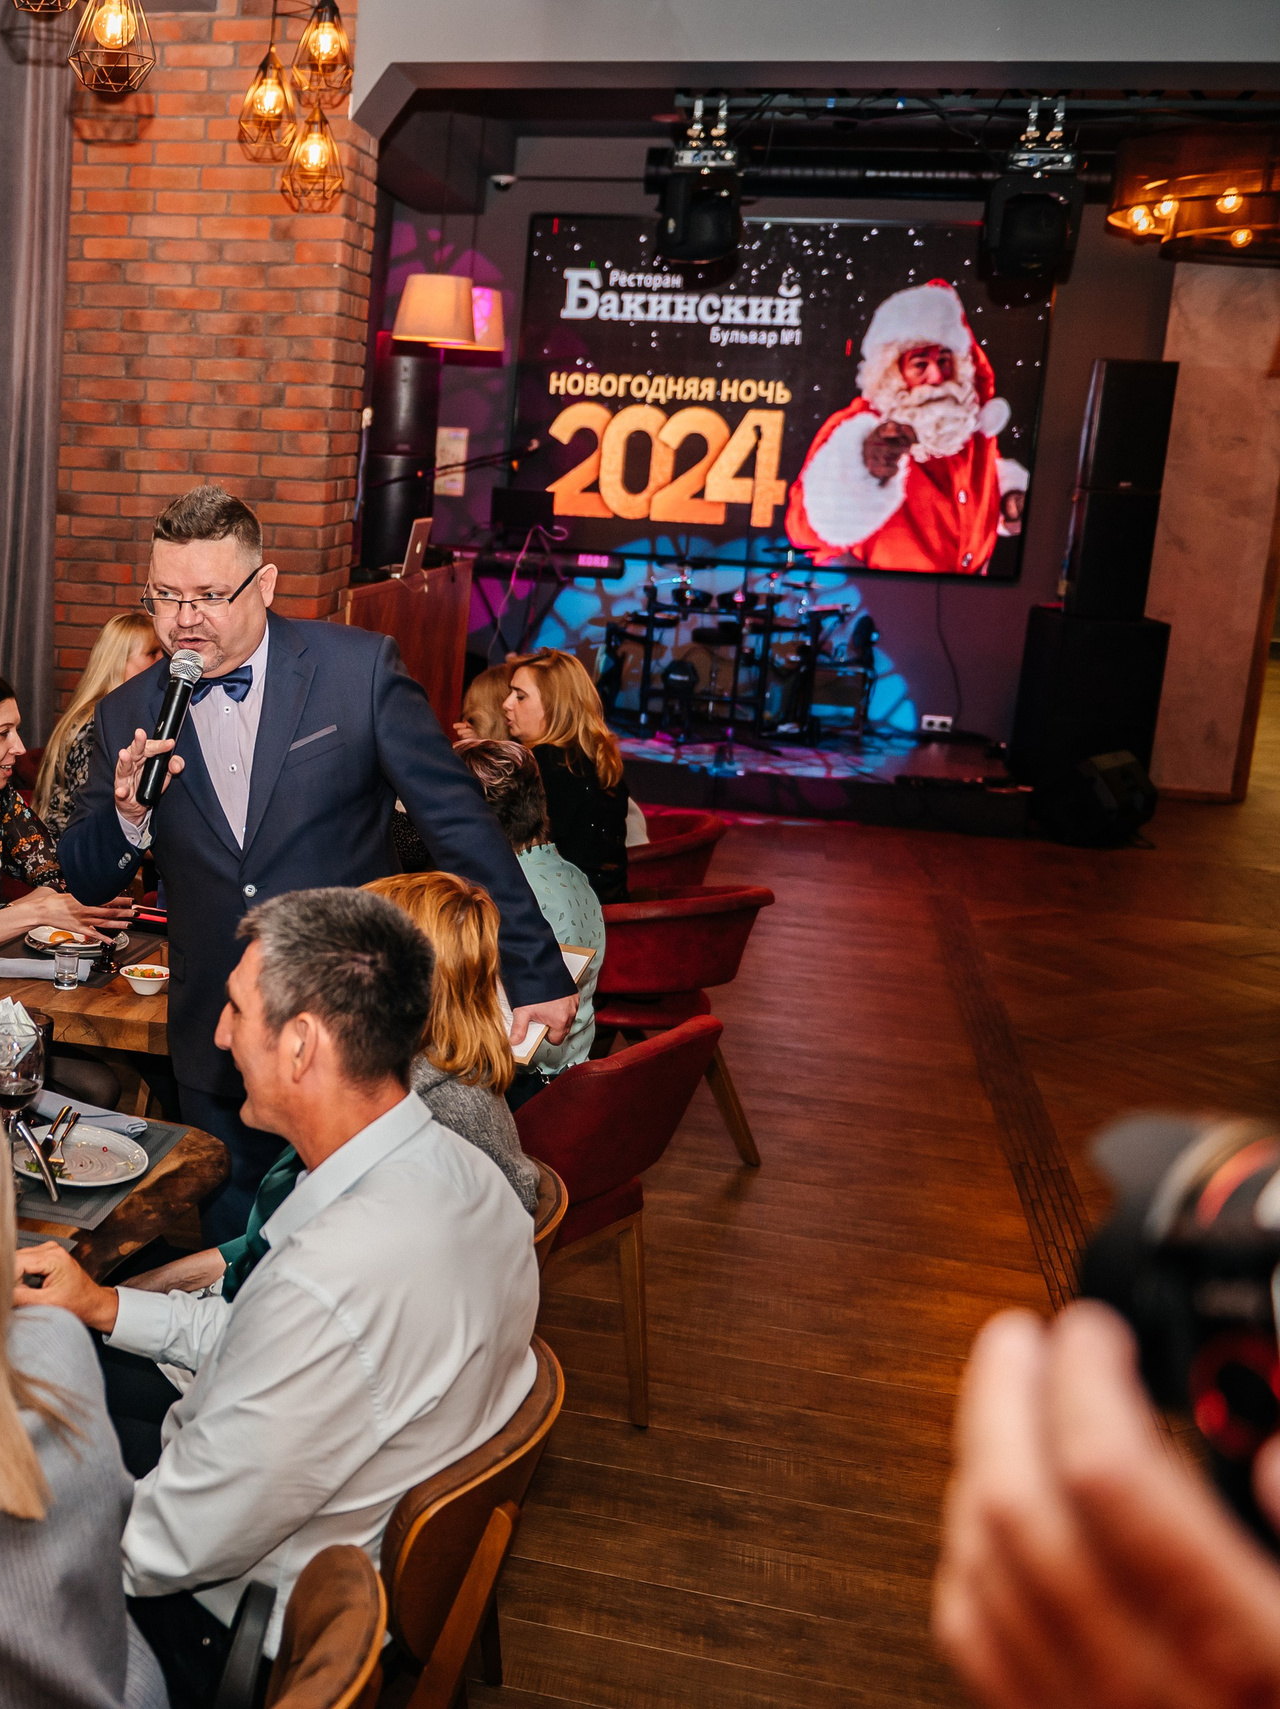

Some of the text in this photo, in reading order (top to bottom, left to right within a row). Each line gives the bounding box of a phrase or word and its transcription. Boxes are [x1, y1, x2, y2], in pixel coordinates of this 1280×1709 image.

[560, 267, 803, 326] Бакинский
[609, 270, 683, 290] Ресторан
[710, 326, 802, 348] Бульвар №1
[549, 371, 792, 404] НОВОГОДНЯЯ НОЧЬ
[546, 401, 787, 527] 2024
